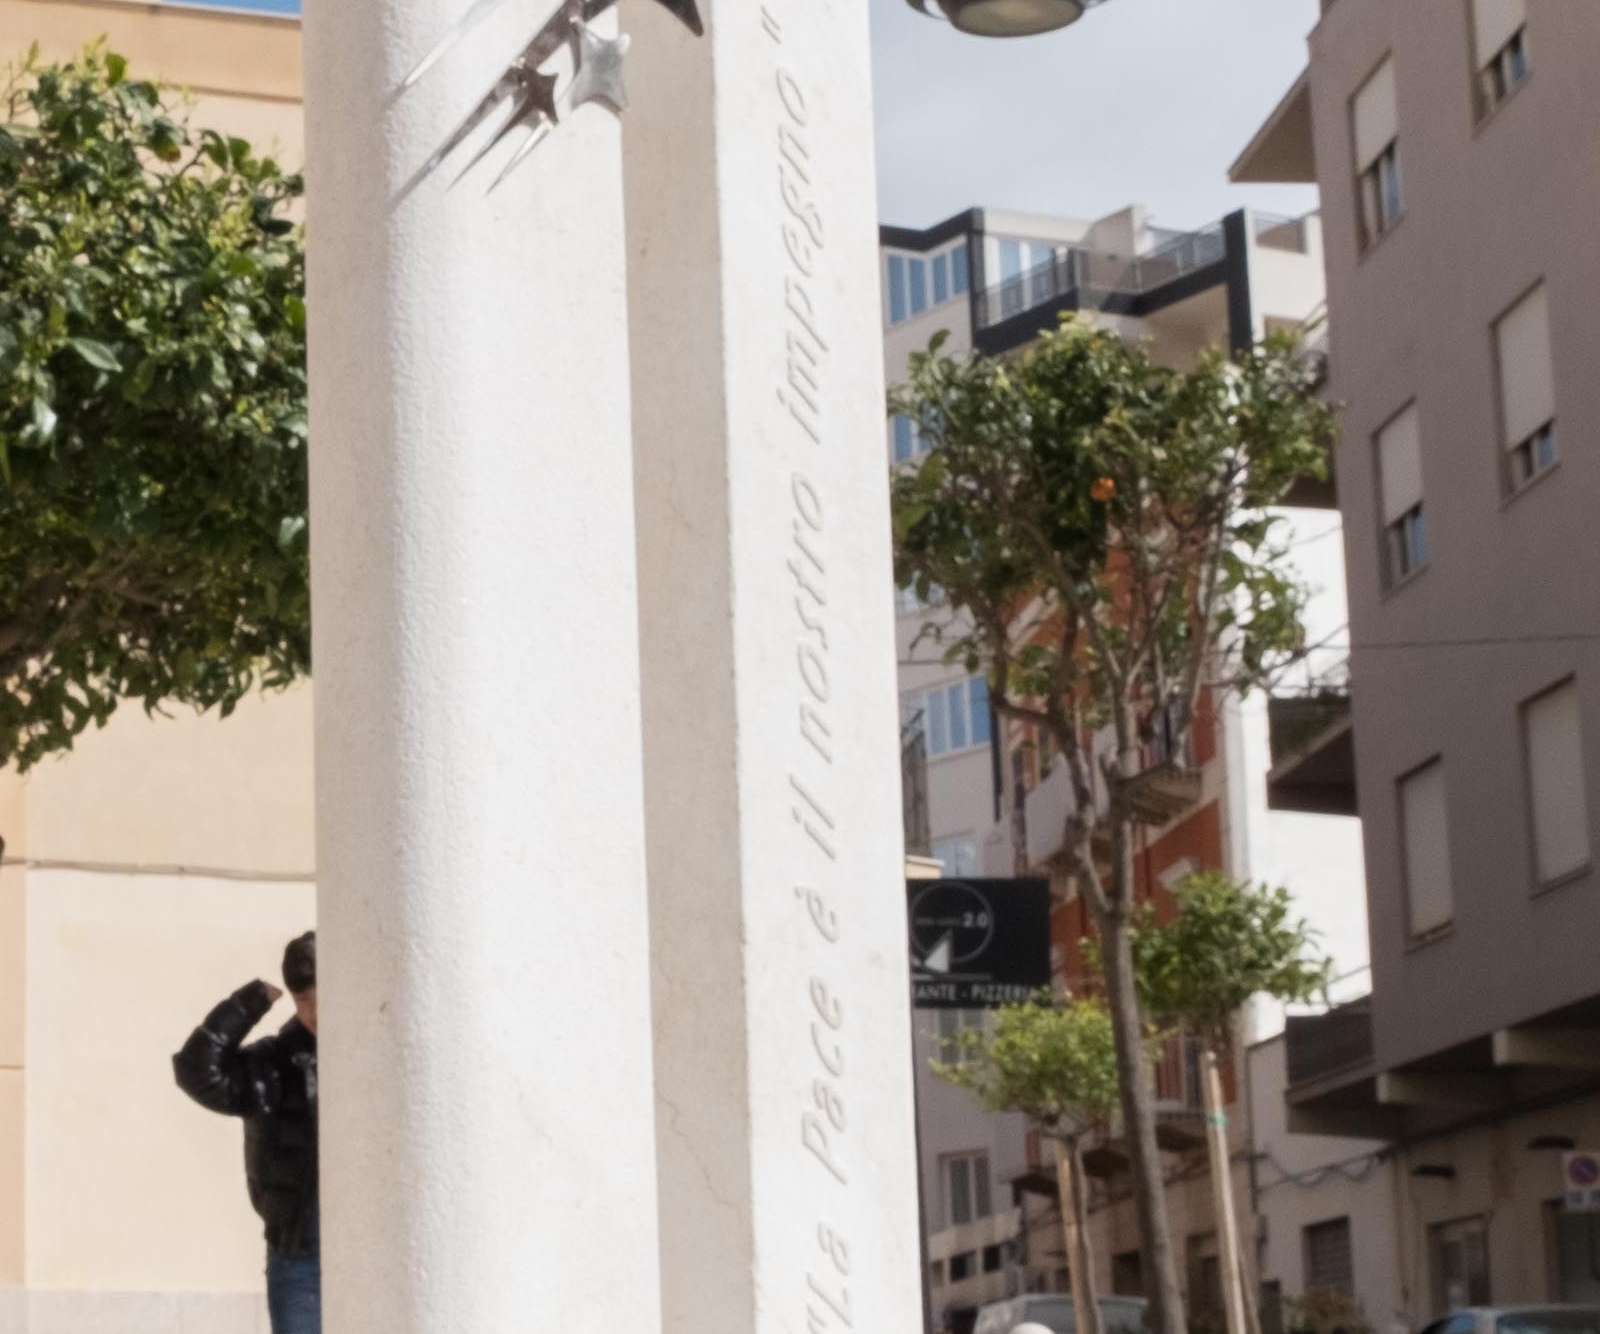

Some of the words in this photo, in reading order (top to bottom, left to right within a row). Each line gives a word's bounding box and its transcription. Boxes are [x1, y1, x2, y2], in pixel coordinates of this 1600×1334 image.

[786, 471, 833, 765] nostro
[788, 773, 836, 862] il
[793, 884, 840, 944] è
[801, 976, 849, 1186] Pace
